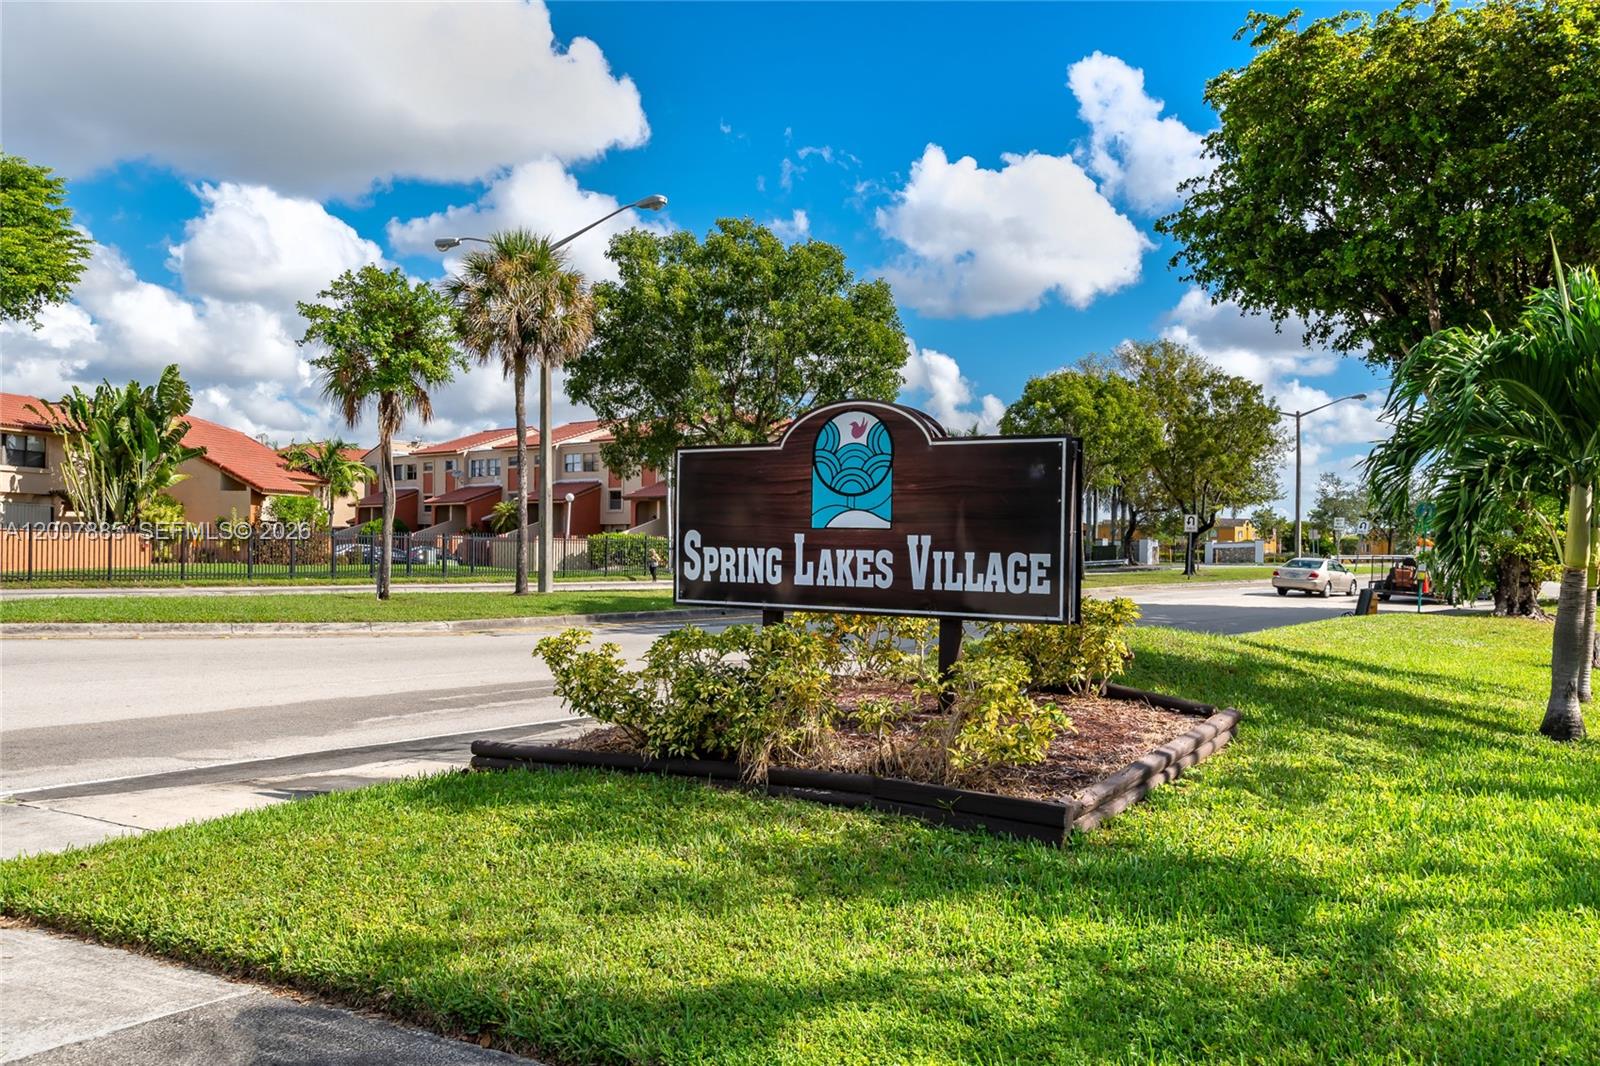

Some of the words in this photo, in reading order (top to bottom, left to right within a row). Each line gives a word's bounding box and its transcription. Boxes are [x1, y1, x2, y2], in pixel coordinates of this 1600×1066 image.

[683, 529, 782, 585] SPRING
[793, 533, 894, 589] LAKES
[906, 534, 1051, 594] VILLAGE
